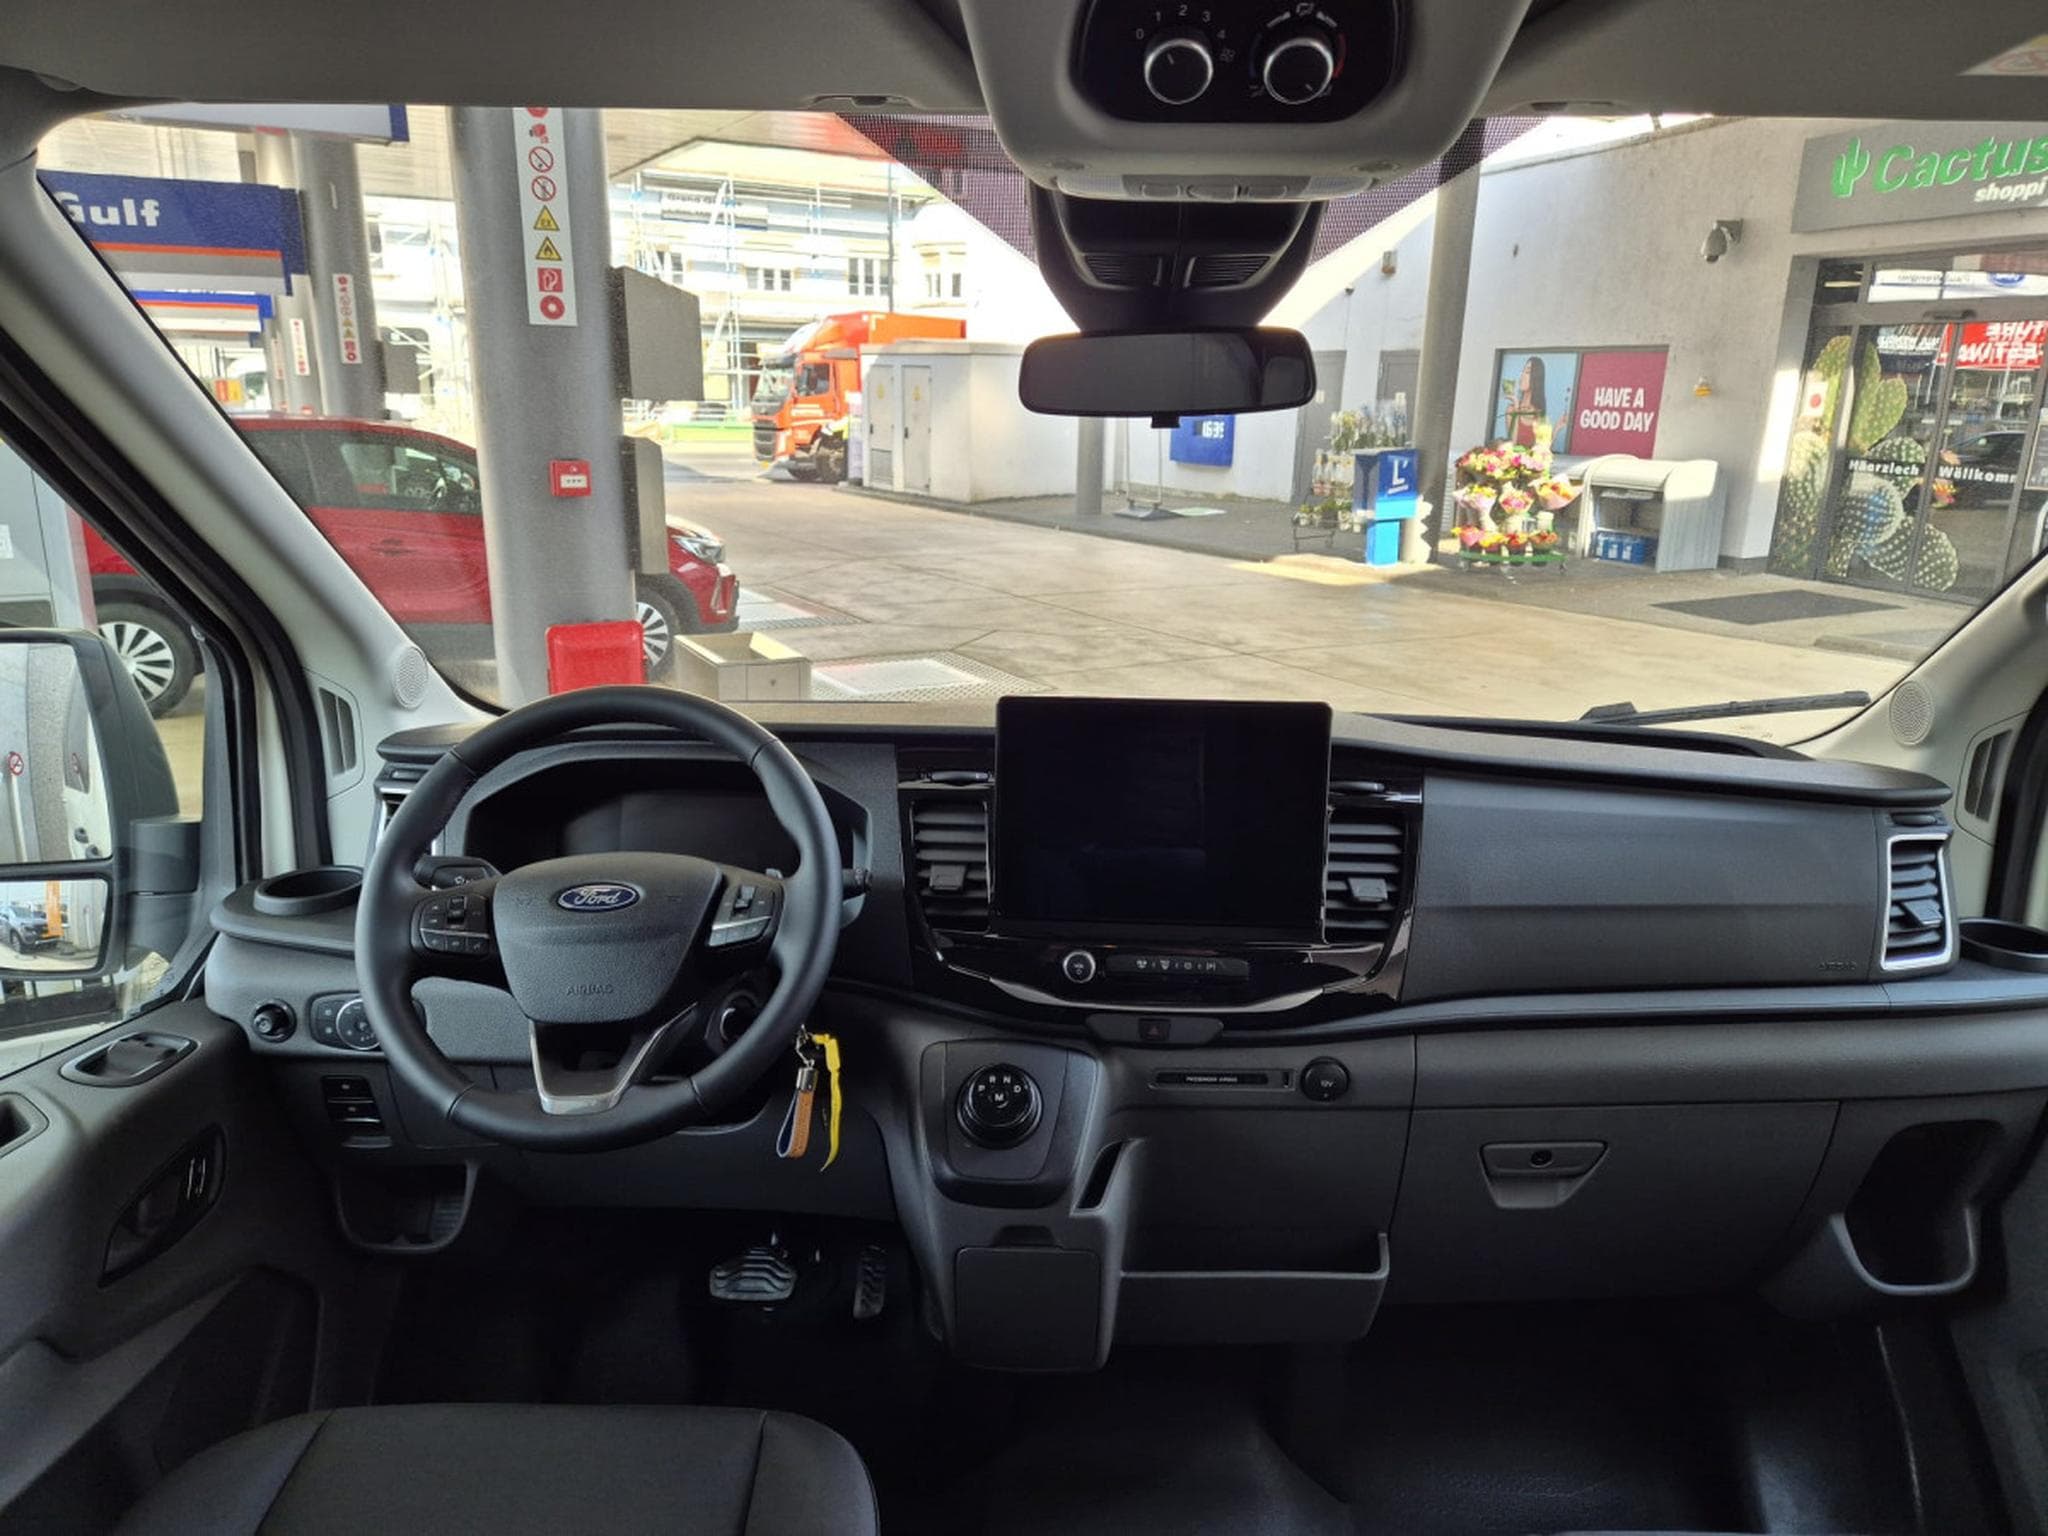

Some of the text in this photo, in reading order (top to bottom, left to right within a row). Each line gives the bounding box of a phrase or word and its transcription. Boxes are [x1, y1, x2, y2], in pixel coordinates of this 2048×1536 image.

[1136, 28, 1144, 39] 0
[1179, 4, 1188, 16] 2
[1202, 11, 1211, 22] 3
[1217, 29, 1226, 39] 4
[1873, 133, 2048, 193] Cactus
[54, 191, 160, 227] Gulf
[1594, 387, 1644, 408] HAVE A
[1580, 409, 1655, 433] GOOD DAY
[574, 887, 621, 904] Ford
[994, 1093, 1004, 1101] M
[1014, 1085, 1022, 1093] D
